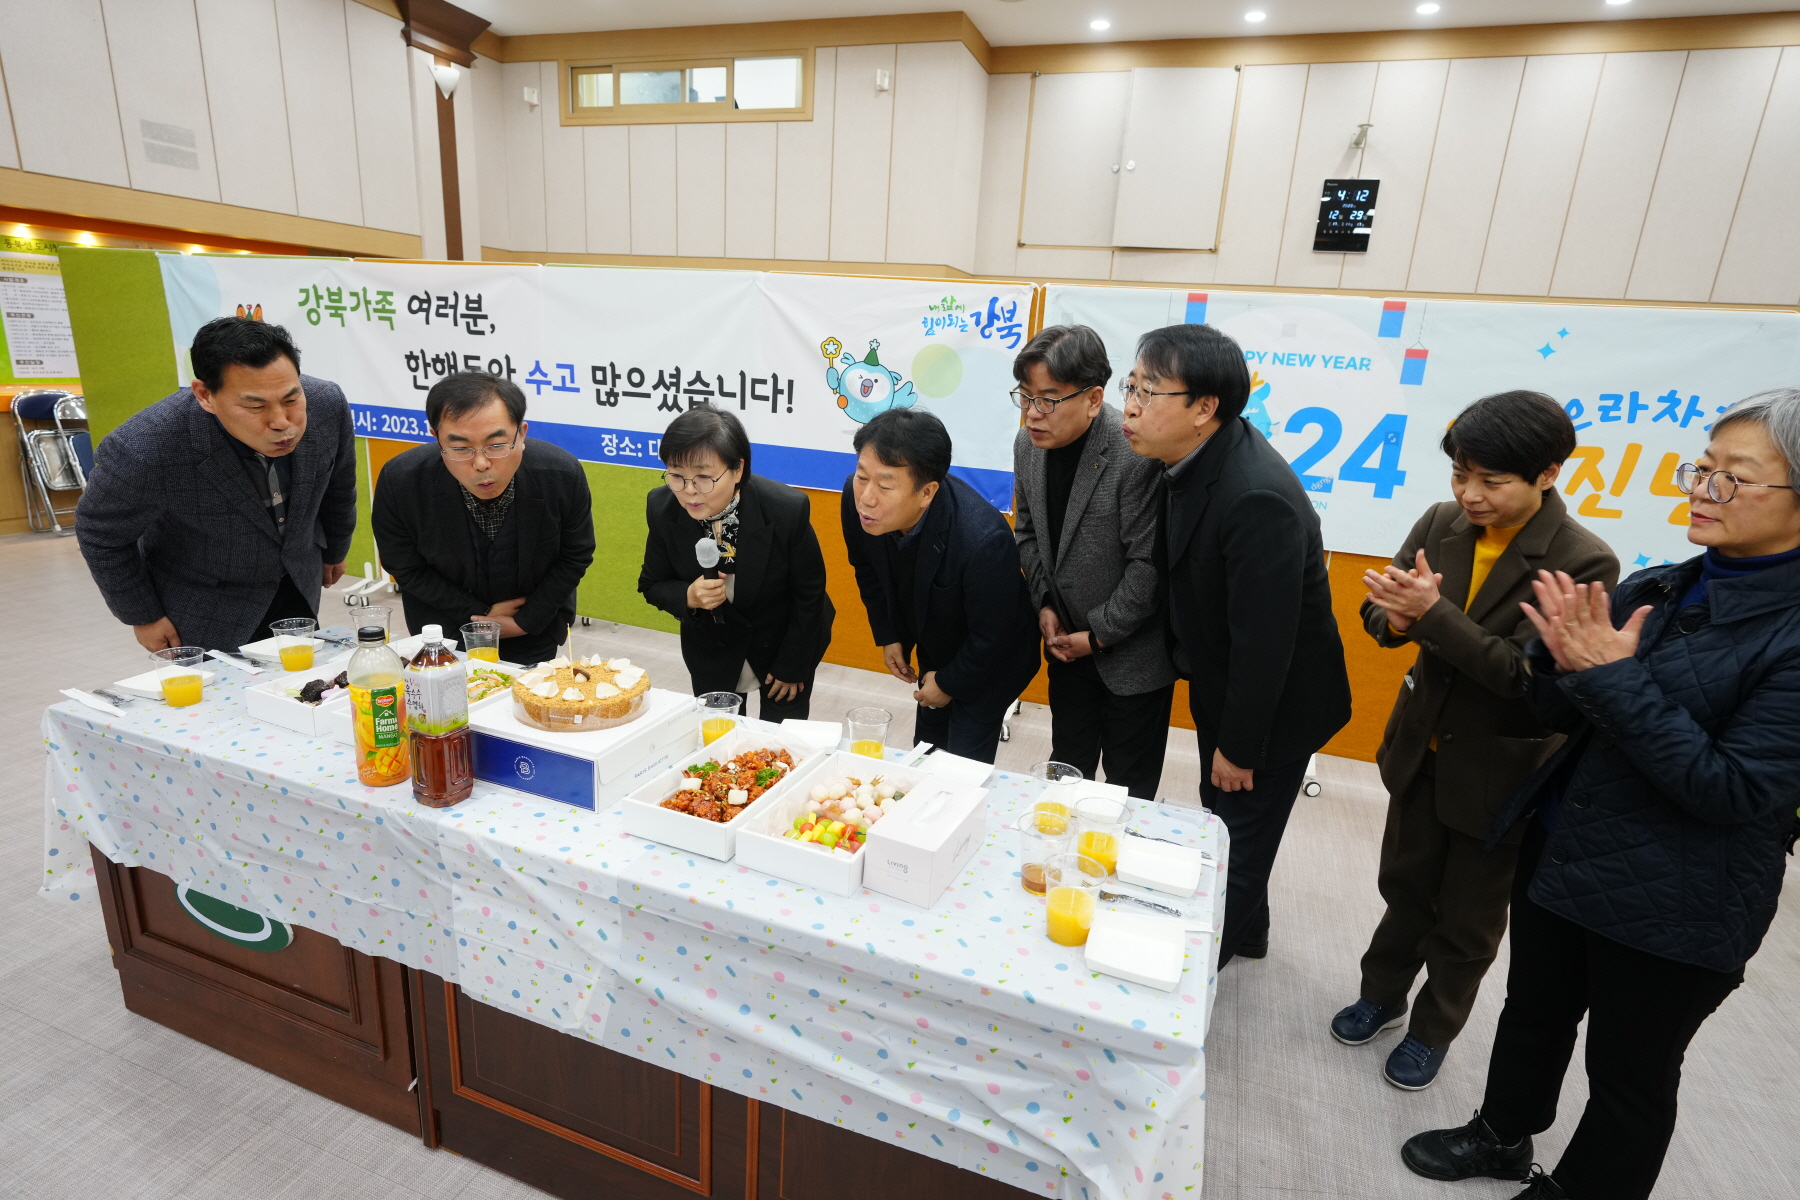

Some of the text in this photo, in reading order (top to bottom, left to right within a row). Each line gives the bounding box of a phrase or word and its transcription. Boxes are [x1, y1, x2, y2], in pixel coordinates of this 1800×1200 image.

[1328, 210, 1364, 220] 12 29
[298, 284, 496, 336] 강북가족 여러분,
[969, 296, 1023, 350] 강북
[1271, 352, 1318, 368] NEW
[1321, 355, 1372, 371] YEAR
[525, 360, 581, 396] 수고
[591, 361, 794, 414] 많으셨습니다!
[601, 433, 643, 458] 장소:
[1284, 406, 1409, 500] 24
[375, 724, 399, 733] Home
